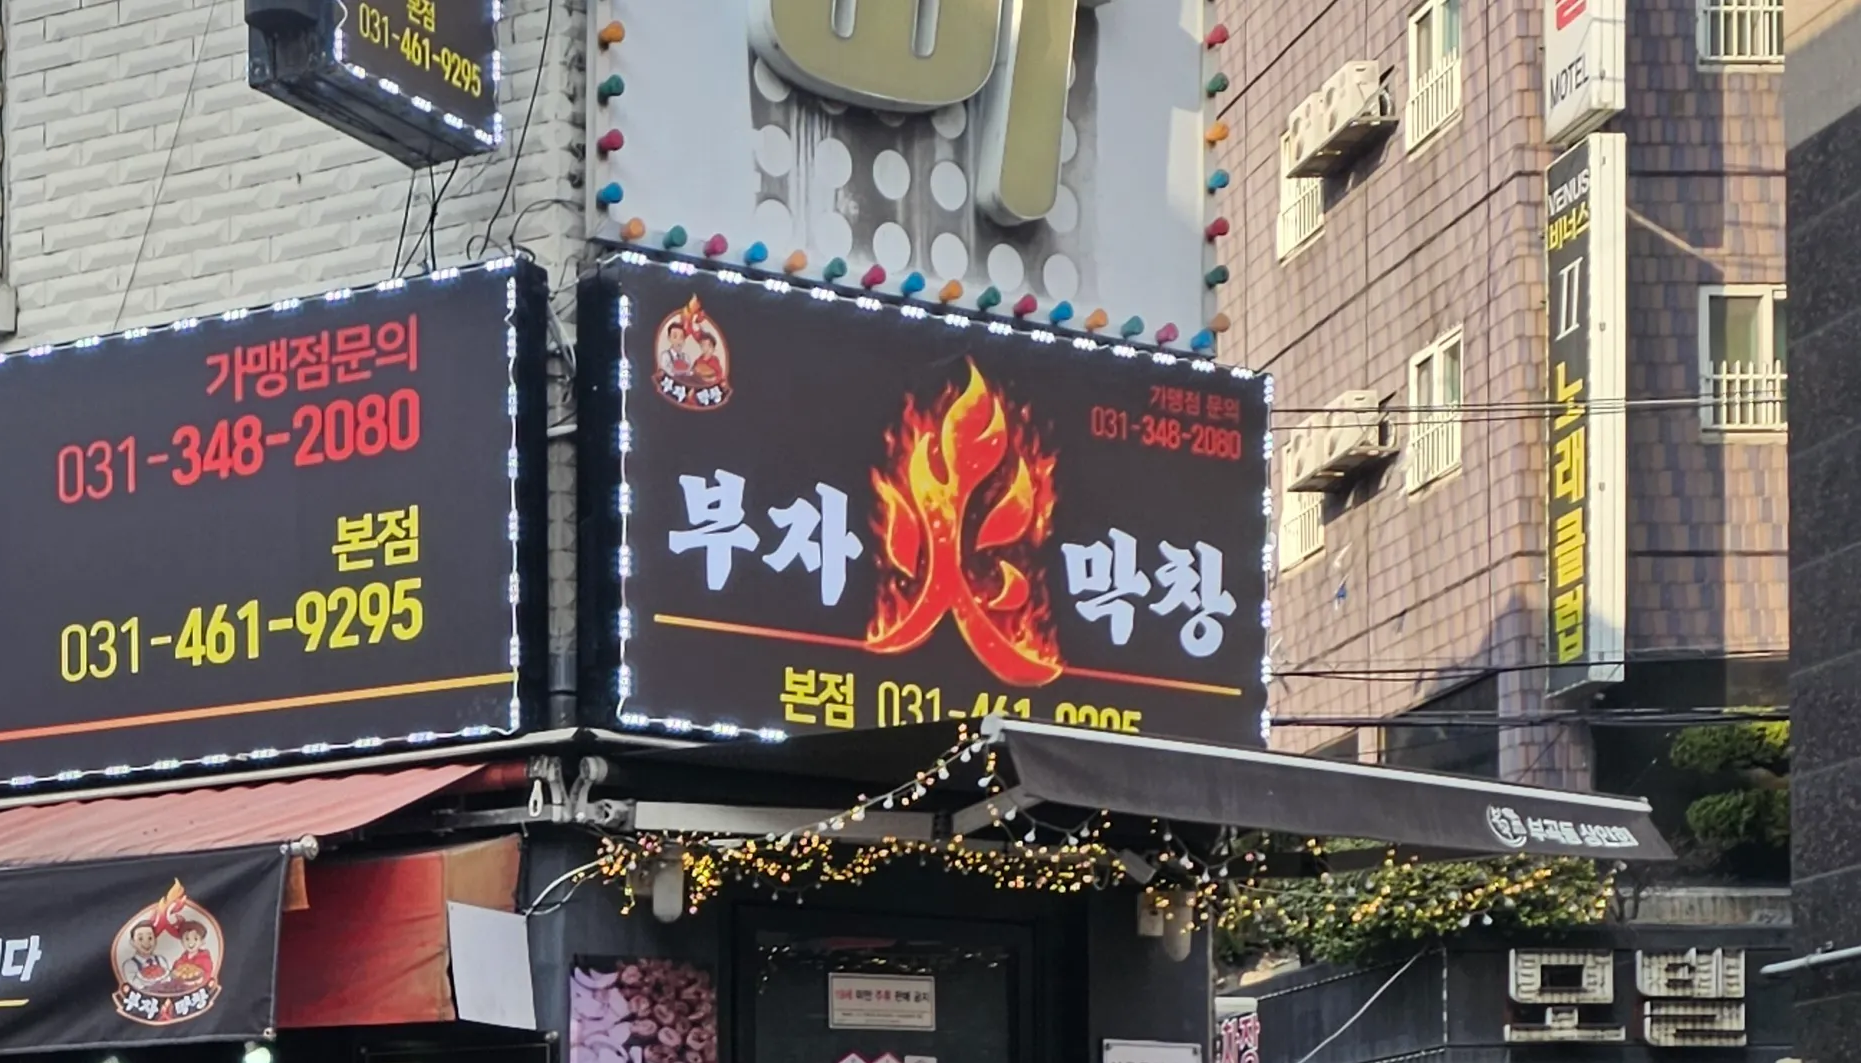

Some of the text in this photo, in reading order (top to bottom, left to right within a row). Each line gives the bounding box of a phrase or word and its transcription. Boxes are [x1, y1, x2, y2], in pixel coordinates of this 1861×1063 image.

[358, 2, 482, 98] 031-461-9295
[1549, 53, 1590, 110] MOTEL
[1548, 168, 1590, 217] VENUS
[1548, 200, 1590, 250] 비너스
[204, 313, 421, 403] 가맹점문의
[1090, 405, 1242, 461] 031-348-2080
[1149, 384, 1242, 424] 가맹점 문의
[55, 388, 422, 504] 031-348-2080
[330, 504, 421, 573] 본점
[1554, 361, 1586, 664] 노래클럽
[668, 467, 865, 607] 부자
[1060, 526, 1238, 659] 막창
[60, 577, 424, 684] 031-461-9295
[779, 665, 856, 730] 본점
[1504, 946, 1748, 1047] 모텔
